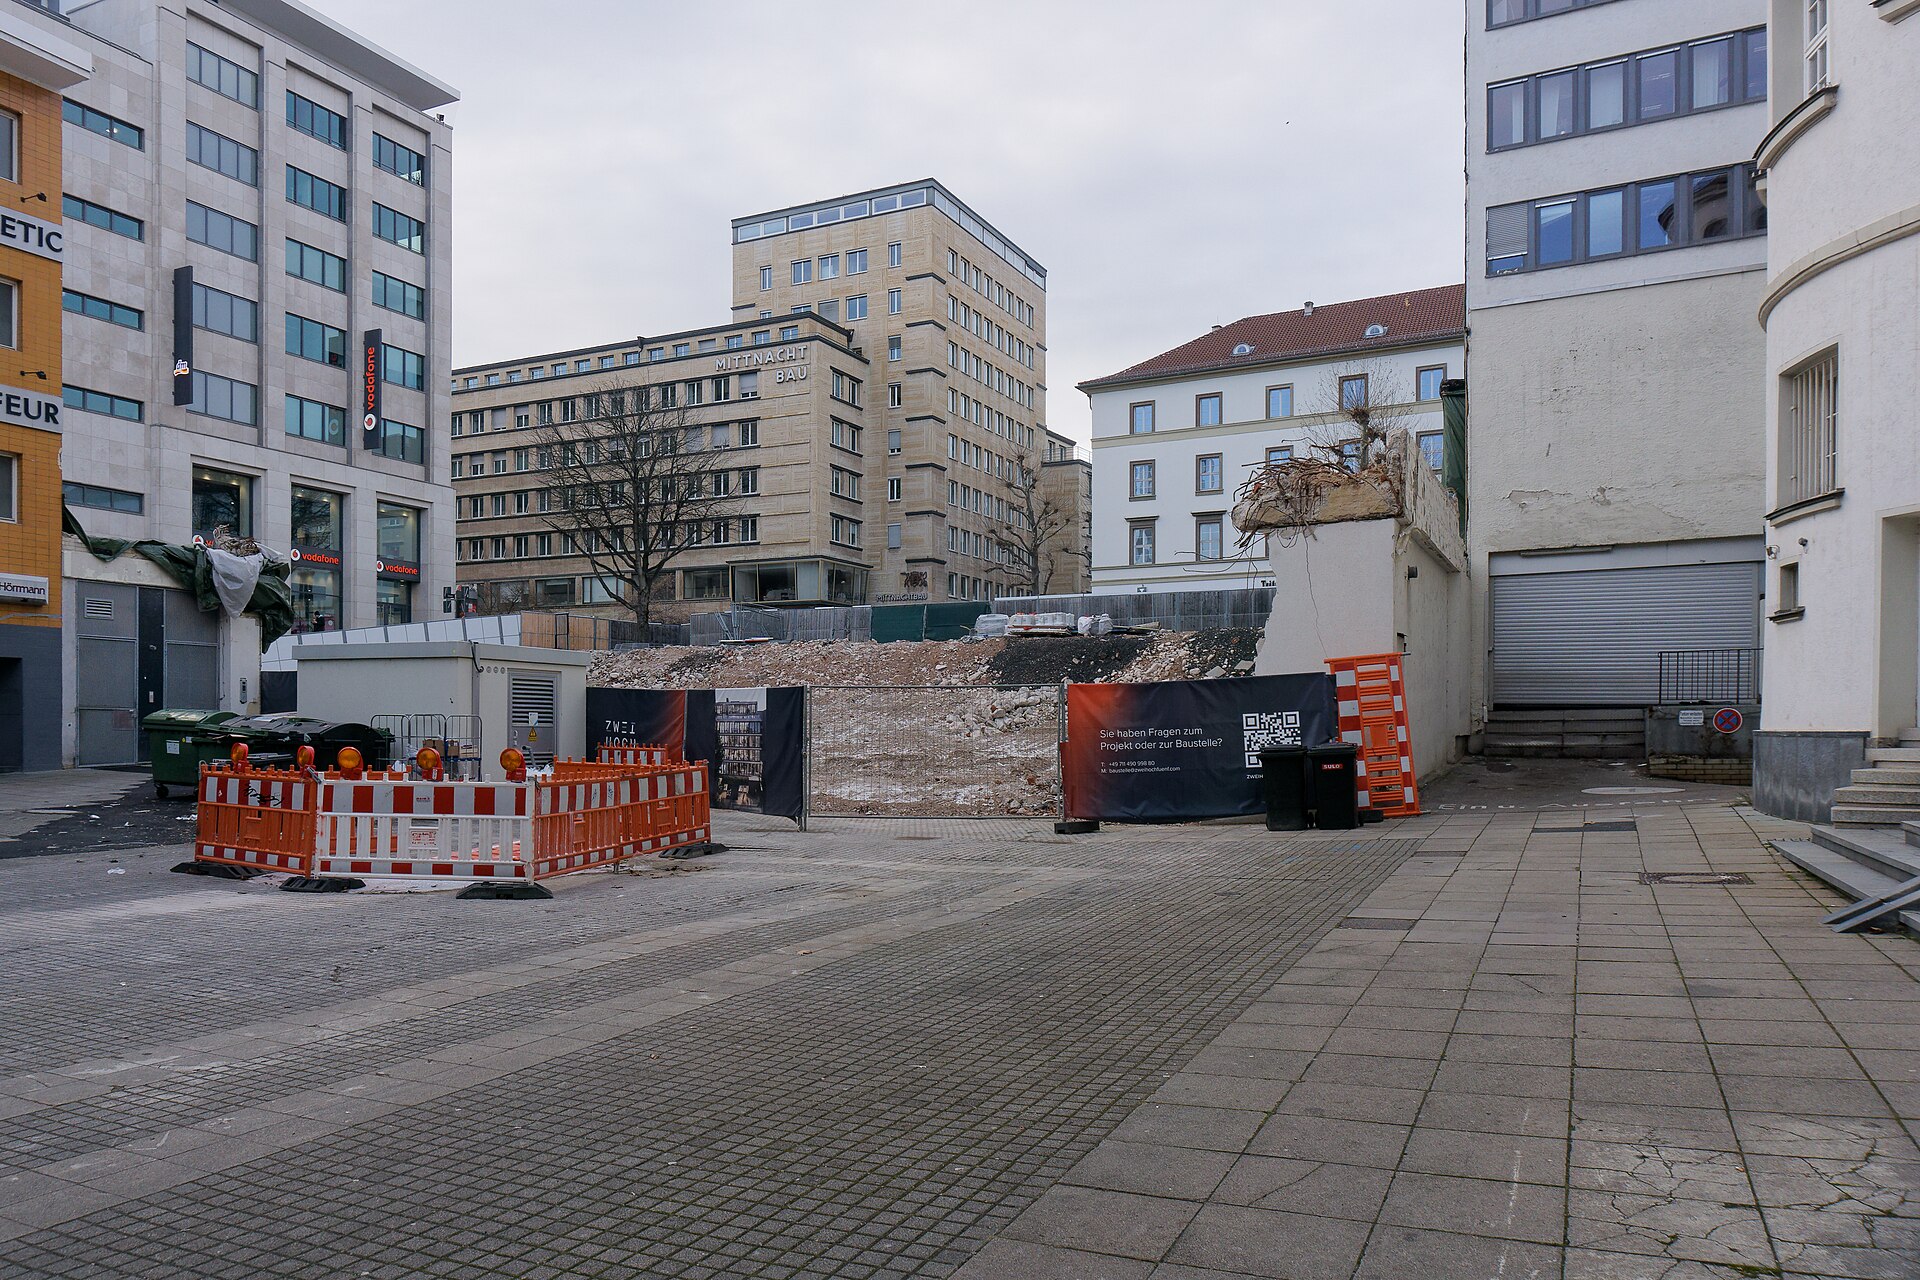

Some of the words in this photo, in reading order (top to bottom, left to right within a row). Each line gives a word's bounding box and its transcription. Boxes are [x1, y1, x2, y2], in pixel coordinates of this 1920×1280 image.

[1, 214, 63, 253] ETIC
[176, 360, 187, 369] dm
[715, 345, 808, 371] MITTNACHT
[366, 346, 375, 411] vodafone
[776, 365, 807, 383] BAU
[0, 391, 59, 425] EUR
[301, 553, 339, 565] vodafone
[385, 564, 418, 575] vodafone
[605, 720, 636, 734] ZWEI
[1100, 729, 1115, 738] Sie
[1117, 729, 1146, 737] haben
[1148, 728, 1181, 738] Fragen
[1100, 741, 1133, 752] Projekt
[1135, 741, 1156, 749] oder
[1158, 741, 1174, 749] zur
[1175, 738, 1223, 748] Baustelle?
